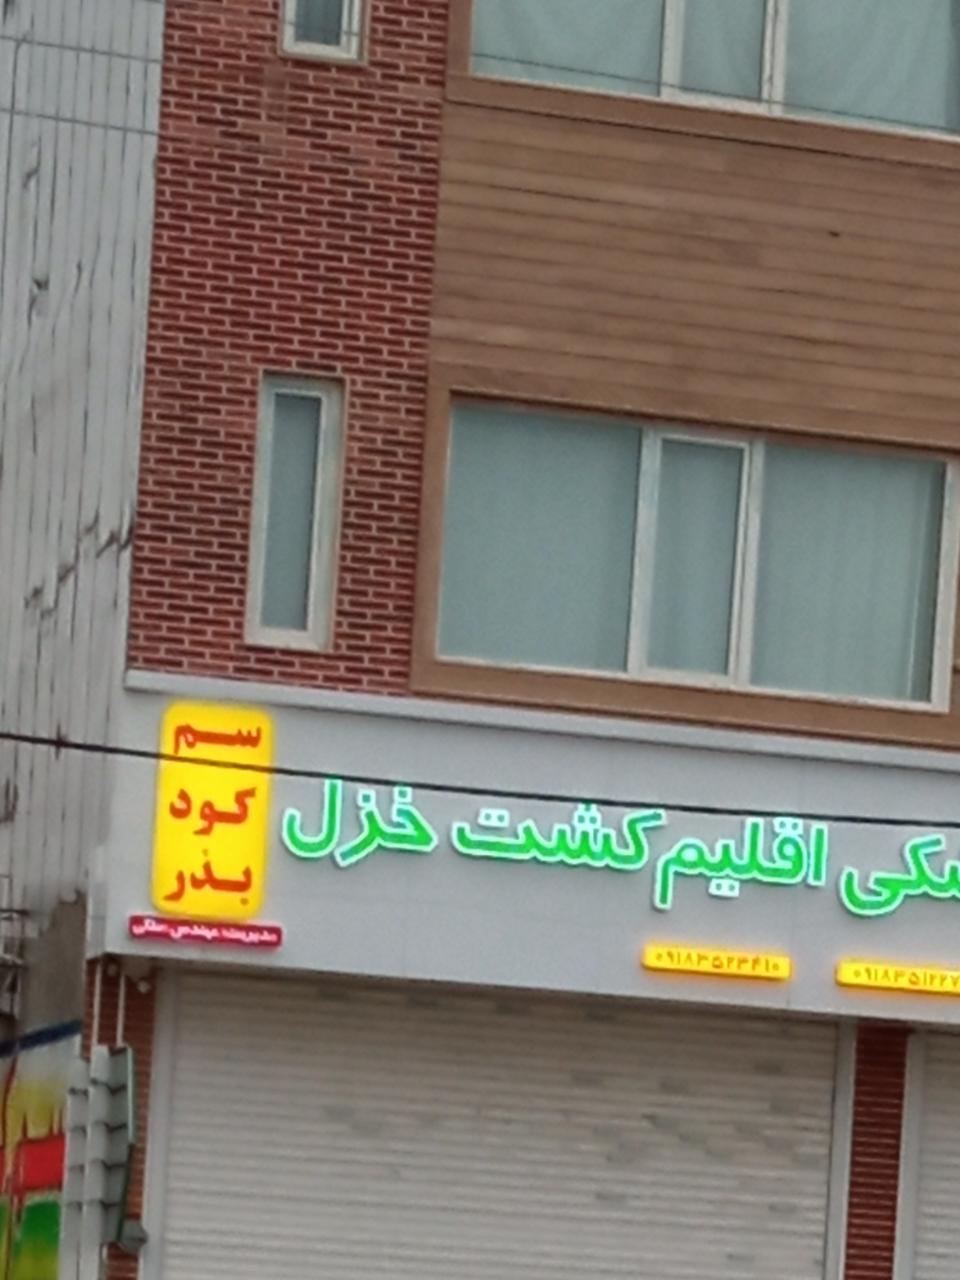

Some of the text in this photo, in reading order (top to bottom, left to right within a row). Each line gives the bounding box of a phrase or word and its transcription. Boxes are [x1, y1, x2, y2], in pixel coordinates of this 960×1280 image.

[174, 723, 262, 755] سم
[168, 787, 256, 836] کود
[282, 777, 438, 867] خزل
[451, 799, 668, 870] کشت
[163, 848, 253, 906] بذر
[653, 815, 829, 912] اقلیم
